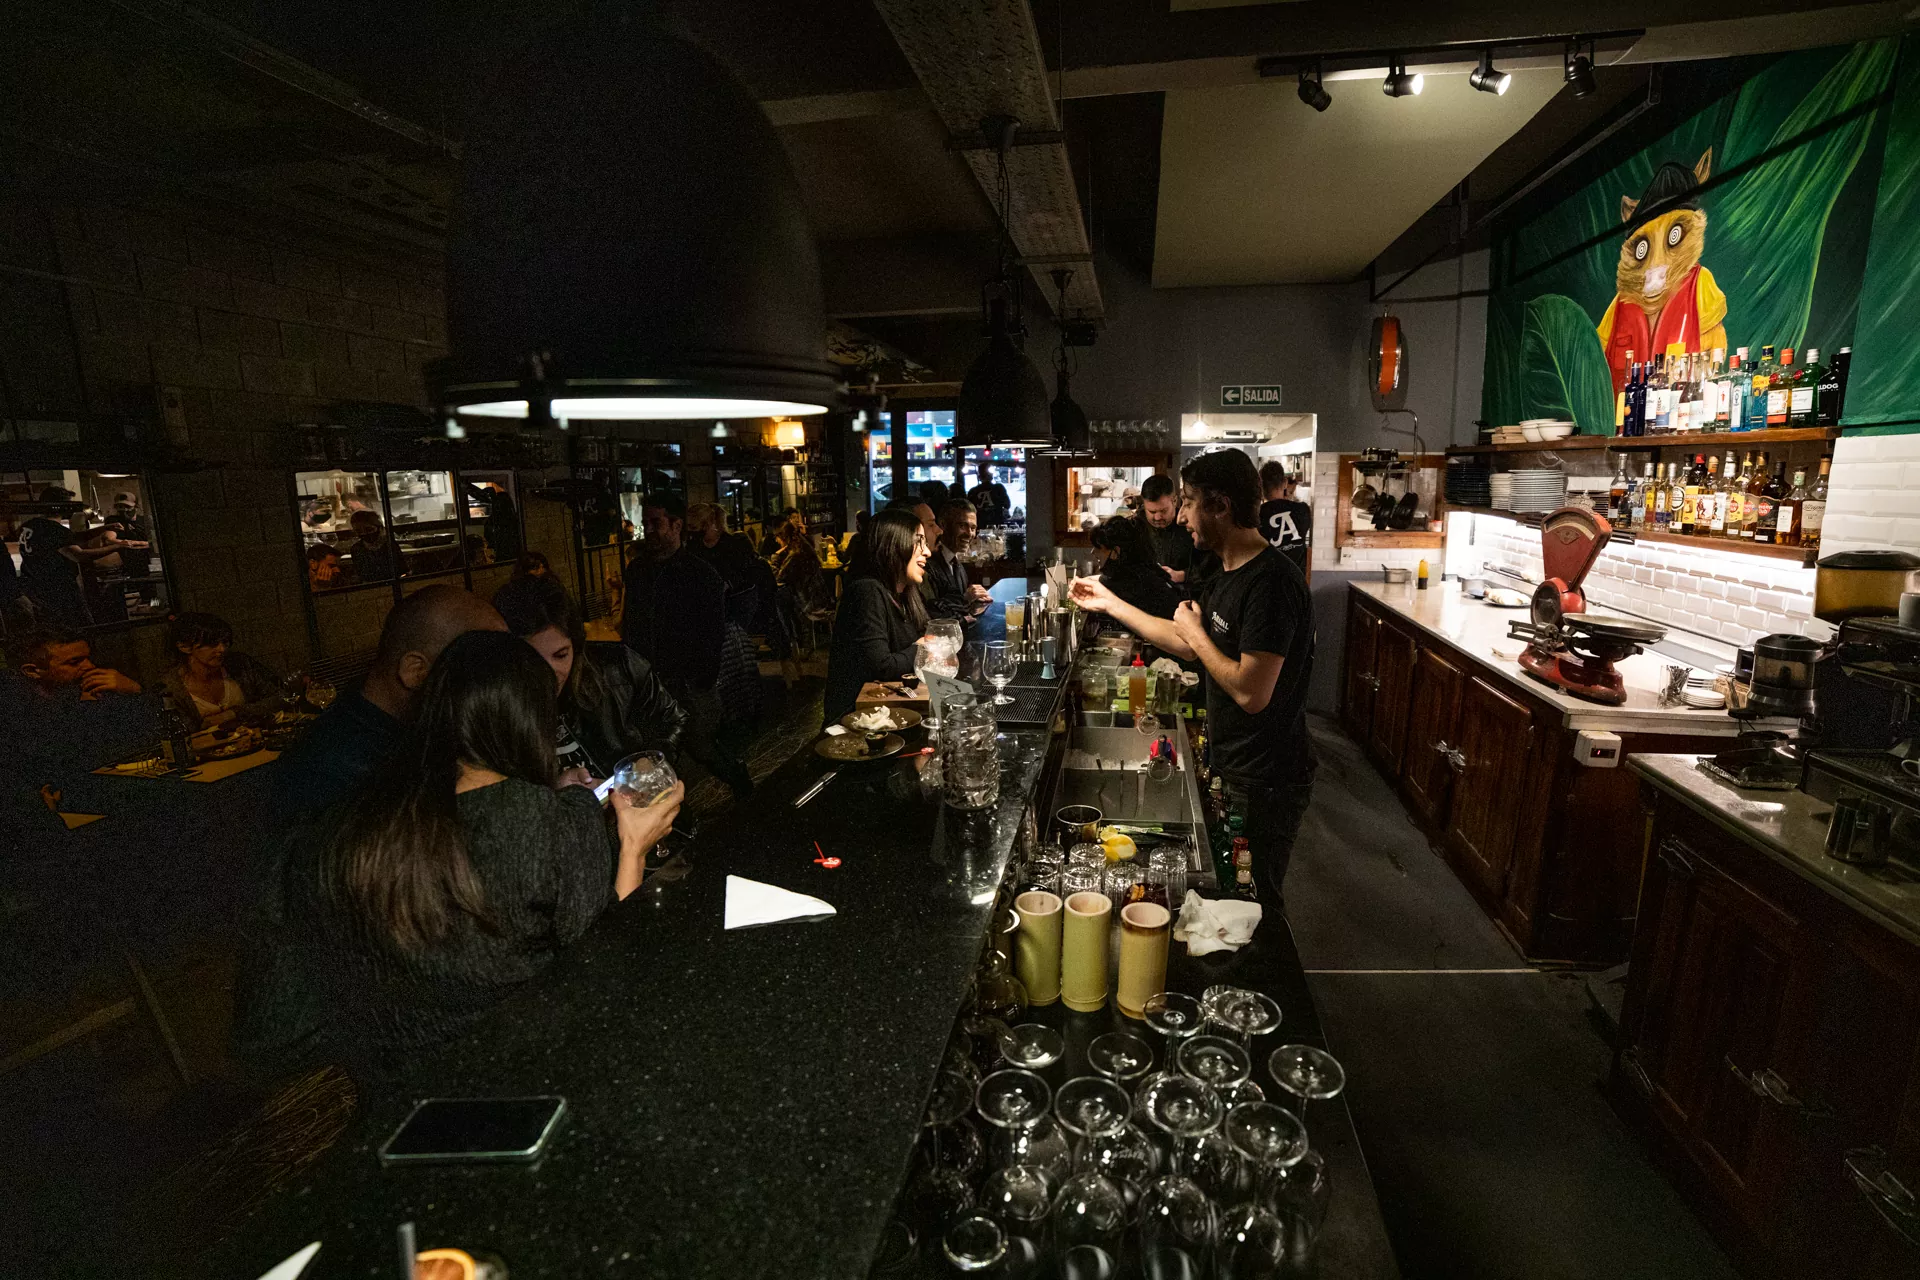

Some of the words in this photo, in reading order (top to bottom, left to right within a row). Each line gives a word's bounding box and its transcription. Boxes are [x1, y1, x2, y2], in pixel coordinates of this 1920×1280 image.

[1244, 390, 1279, 402] SALIDA
[977, 490, 995, 509] A
[1269, 510, 1303, 547] A
